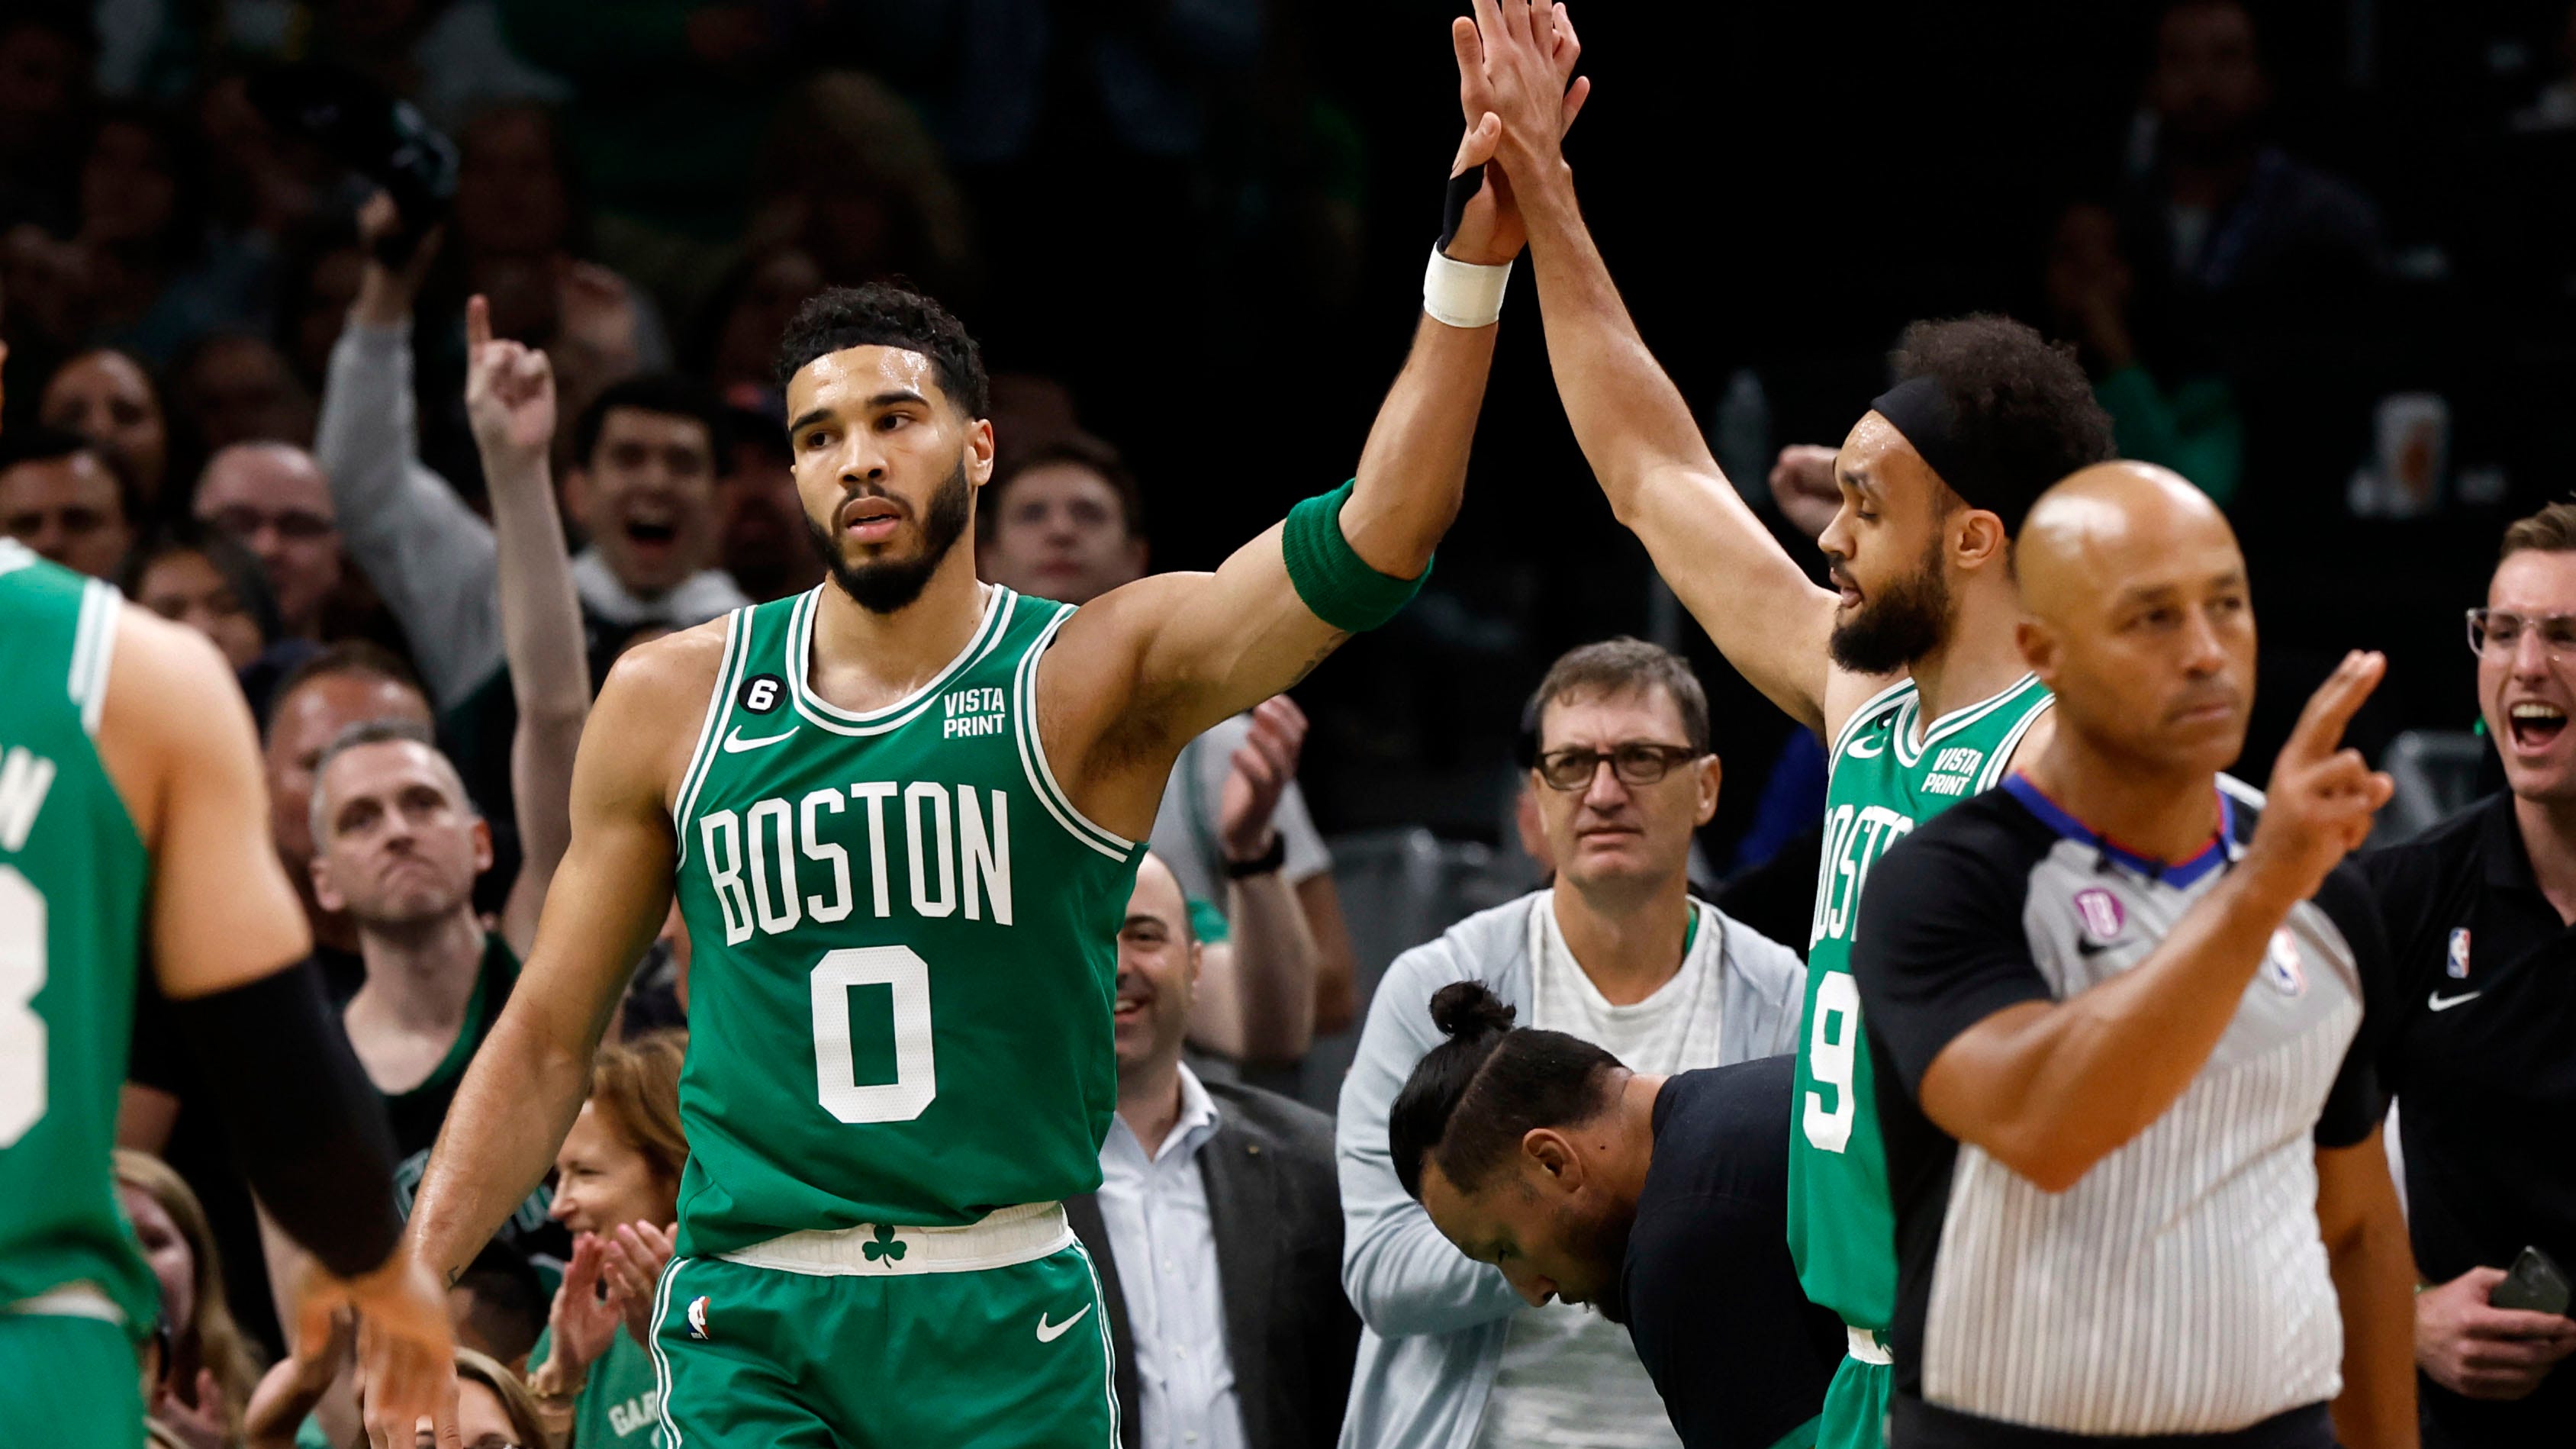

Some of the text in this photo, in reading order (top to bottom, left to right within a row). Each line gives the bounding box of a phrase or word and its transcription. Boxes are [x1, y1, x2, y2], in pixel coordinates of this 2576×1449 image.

[747, 679, 778, 710] 6
[943, 687, 1005, 717] VISTA
[943, 713, 1005, 739] PRINT
[1932, 748, 1983, 777] VISTA
[1921, 773, 1970, 796] PRINT
[700, 781, 1013, 946] BOSTON
[810, 945, 936, 1123] 0
[1802, 971, 1860, 1154] 9
